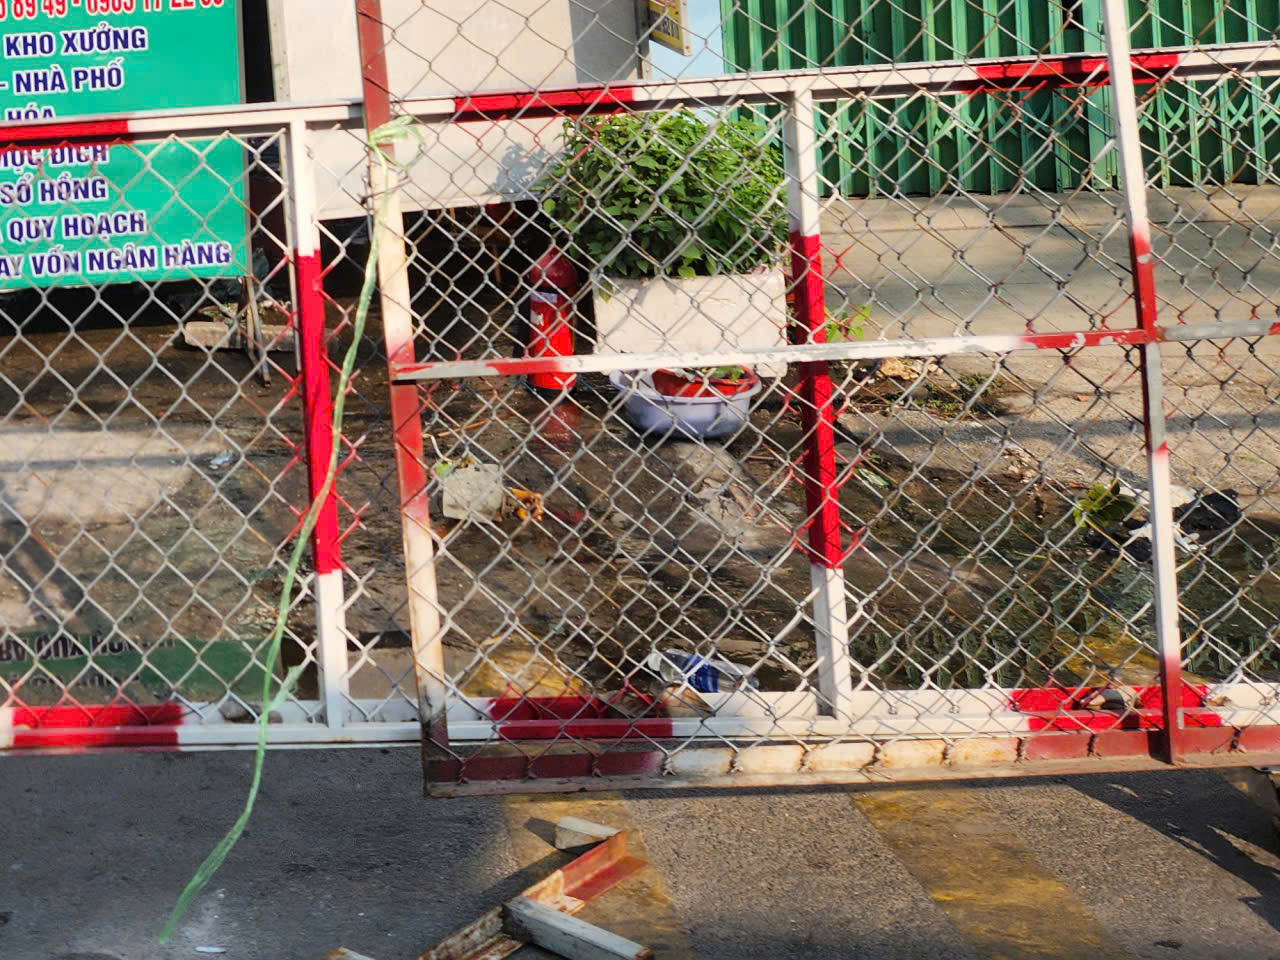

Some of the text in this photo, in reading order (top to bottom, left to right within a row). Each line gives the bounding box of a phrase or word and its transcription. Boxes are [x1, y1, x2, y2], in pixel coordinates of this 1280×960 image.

[5, 33, 55, 57] KHO
[62, 23, 147, 54] XƯỞNG
[15, 66, 66, 93] NHÀ
[74, 57, 125, 90] PHỐ
[9, 216, 56, 242] QUY
[64, 212, 146, 242] HOẠCH
[88, 244, 156, 272] NGÂN
[164, 240, 231, 267] HÀNG
